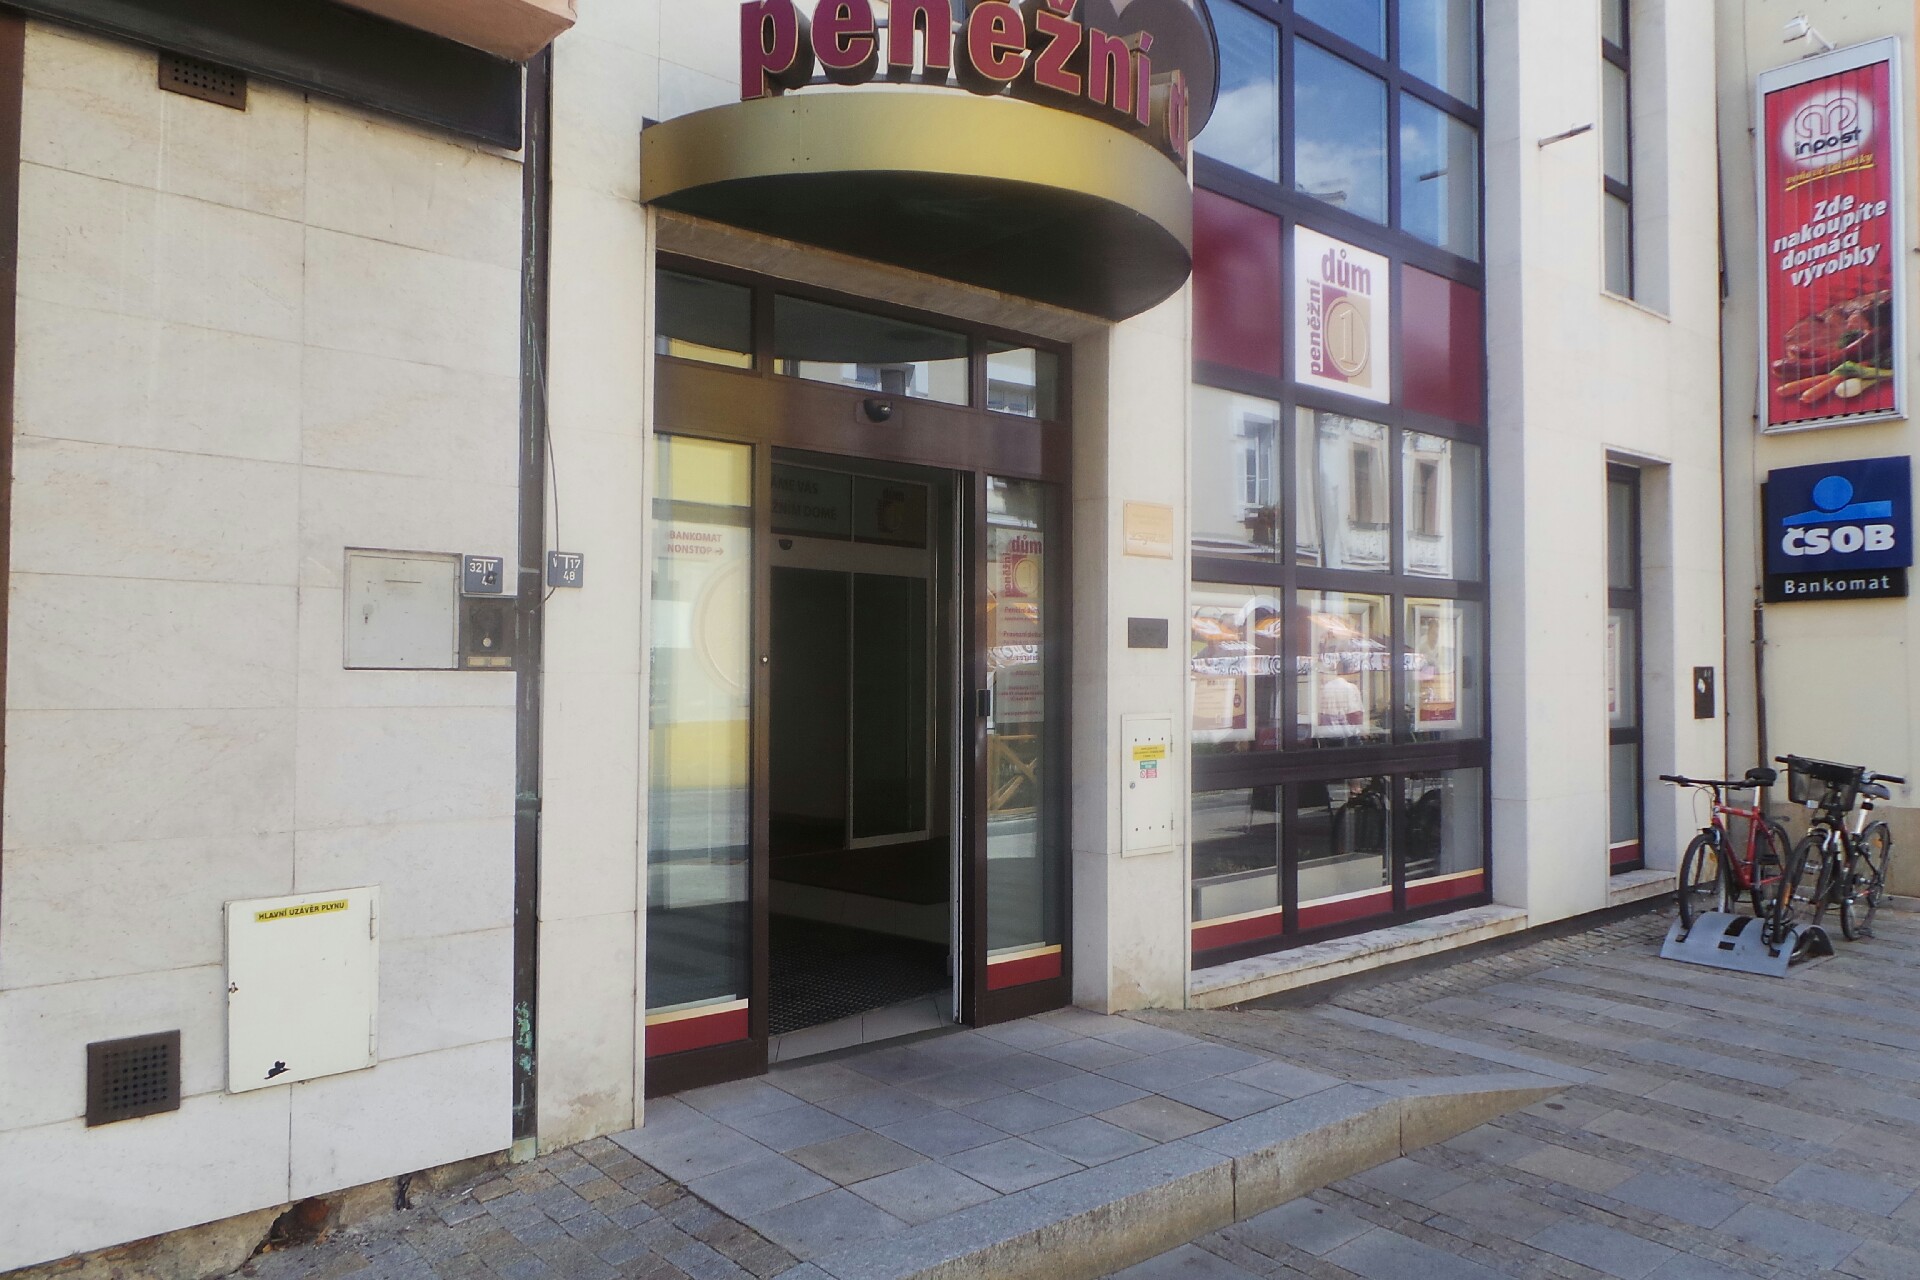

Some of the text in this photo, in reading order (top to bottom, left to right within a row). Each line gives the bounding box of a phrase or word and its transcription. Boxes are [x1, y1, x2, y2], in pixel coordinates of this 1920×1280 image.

[1813, 194, 1855, 222] Zde
[1773, 200, 1887, 254] nakoupíte
[1782, 225, 1861, 270] domácí
[1321, 248, 1371, 296] dům
[1791, 243, 1881, 287] výrobky
[1307, 277, 1321, 376] peněžní
[669, 530, 723, 542] BANKOMAT
[1011, 534, 1042, 554] dům
[1782, 524, 1896, 557] ČSOB
[667, 544, 713, 555] NONSTOP
[469, 562, 494, 573] 32 V
[570, 559, 581, 569] 17
[563, 570, 576, 581] 48
[1784, 576, 1890, 594] Bankomat
[258, 901, 345, 921] HLAVNÍ UZÁVĚR PLYNU
